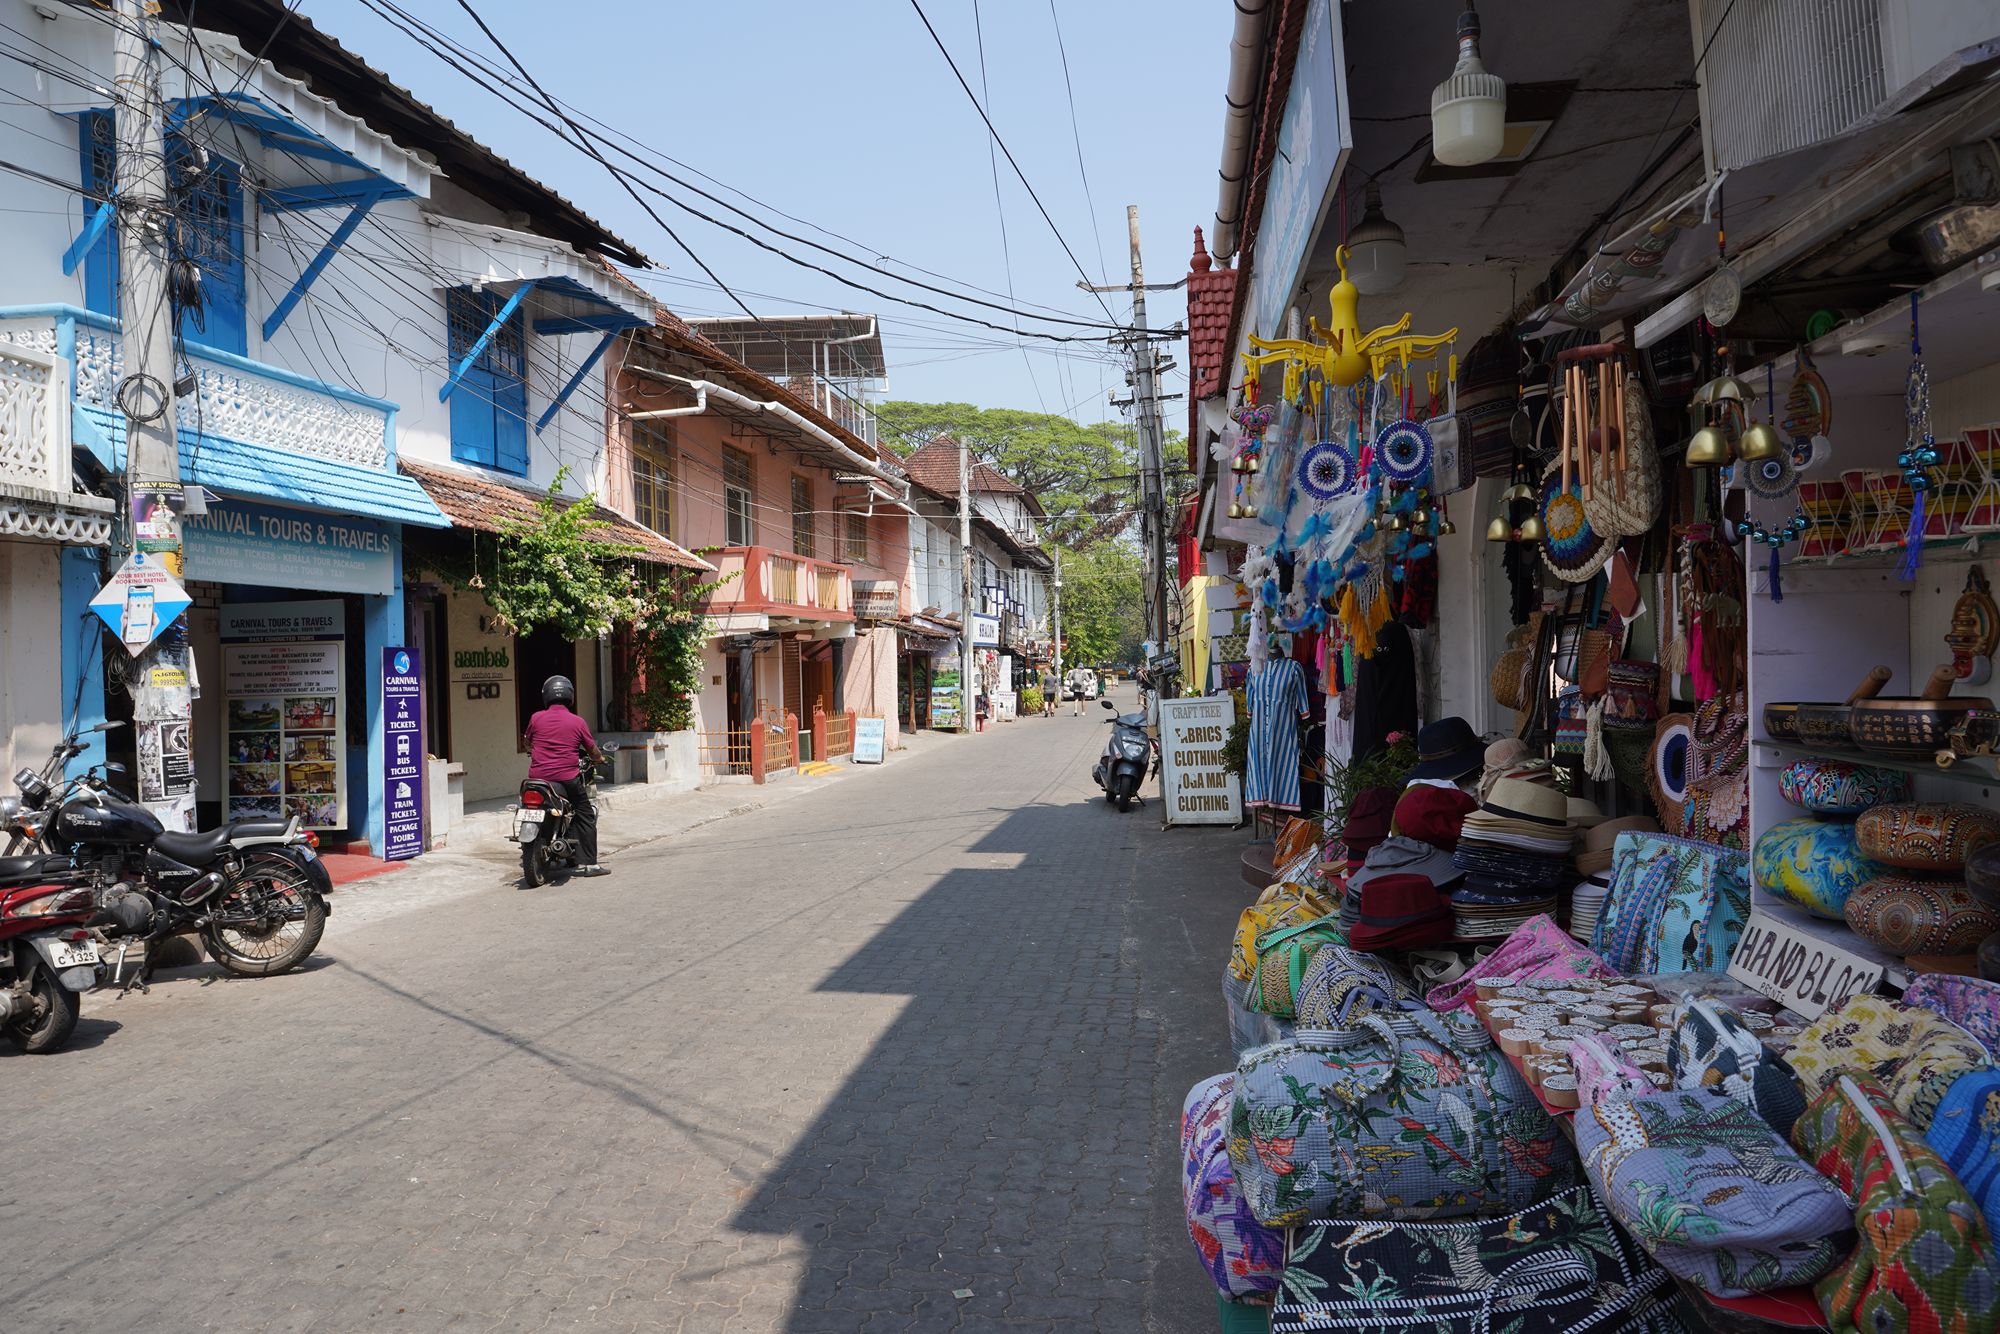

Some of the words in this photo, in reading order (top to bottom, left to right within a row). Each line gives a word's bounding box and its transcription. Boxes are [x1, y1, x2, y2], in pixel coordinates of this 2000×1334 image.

[182, 509, 255, 537] ARNIVAL
[259, 516, 312, 544] TOURS
[317, 525, 326, 545] &
[330, 526, 390, 554] TRAVELS
[231, 618, 266, 628] CARNIVAL
[268, 618, 291, 628] TOURS
[302, 616, 333, 627] TRAVELS
[1172, 706, 1198, 719] CRAFT
[1200, 705, 1222, 718] TREE
[397, 757, 410, 765] BUS
[1174, 750, 1225, 766] CLOTHING
[391, 766, 416, 775] TICKETS
[1206, 772, 1227, 788] MAT
[394, 800, 413, 808] TRAIN
[1178, 795, 1229, 812] CLOTHING
[391, 809, 416, 819] TICKETS
[390, 823, 418, 833] PACKAGE
[393, 833, 415, 843] TOURS
[58, 956, 66, 964] C
[70, 952, 94, 963] 1325
[1760, 982, 1786, 1004] PRINTS
